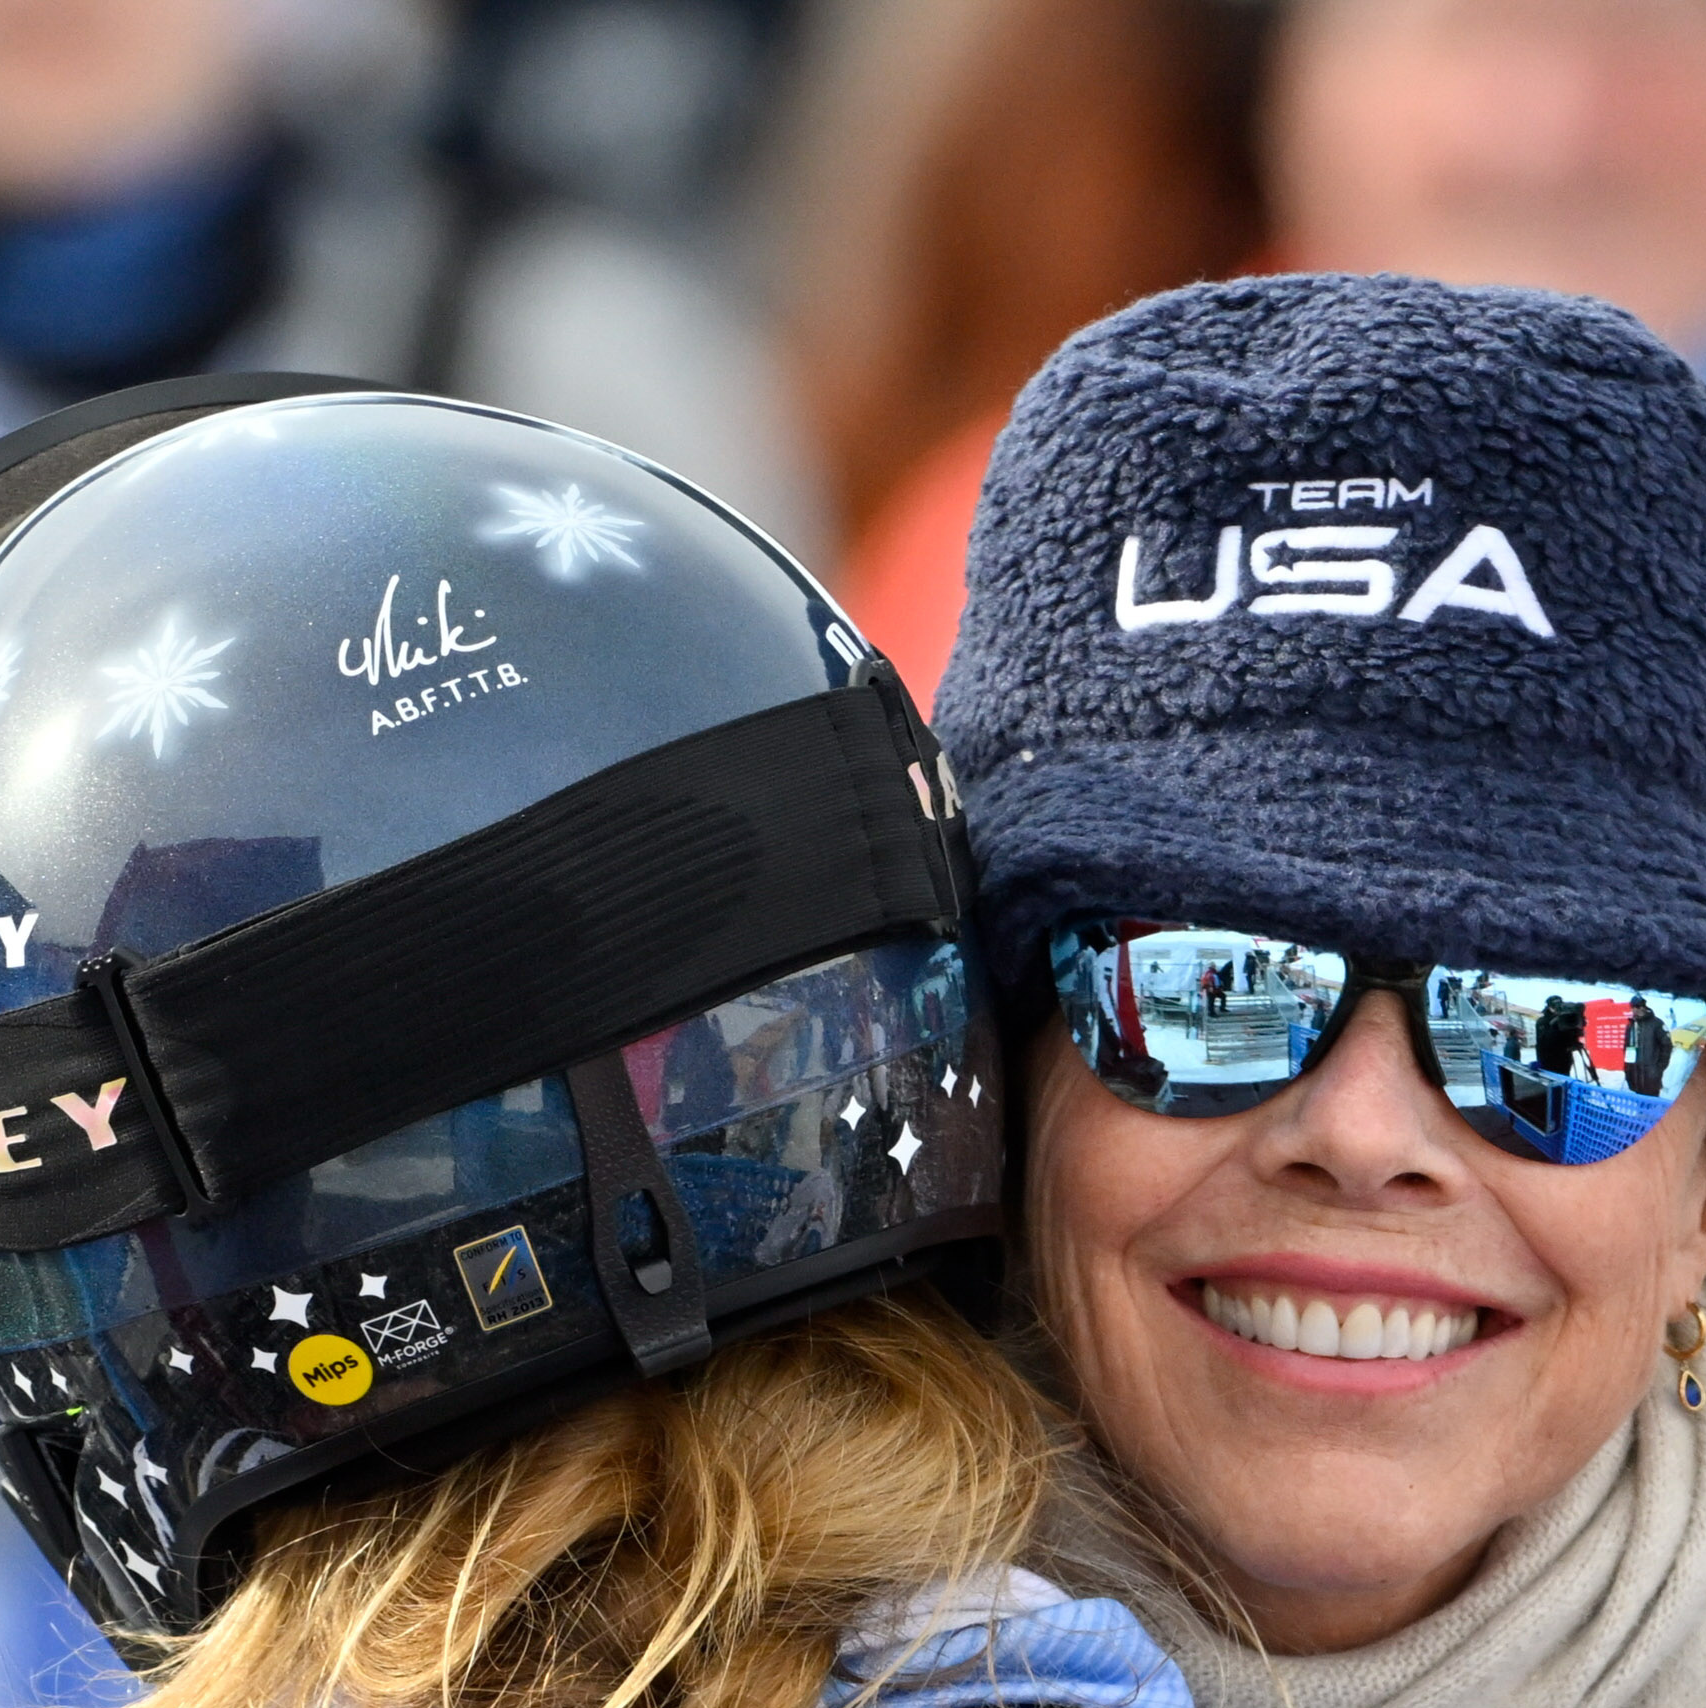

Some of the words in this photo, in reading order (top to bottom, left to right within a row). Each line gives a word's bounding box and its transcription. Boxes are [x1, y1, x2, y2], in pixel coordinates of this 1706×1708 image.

[1248, 476, 1434, 512] TEAM
[1114, 523, 1557, 638] USA
[301, 1353, 360, 1388] Mips
